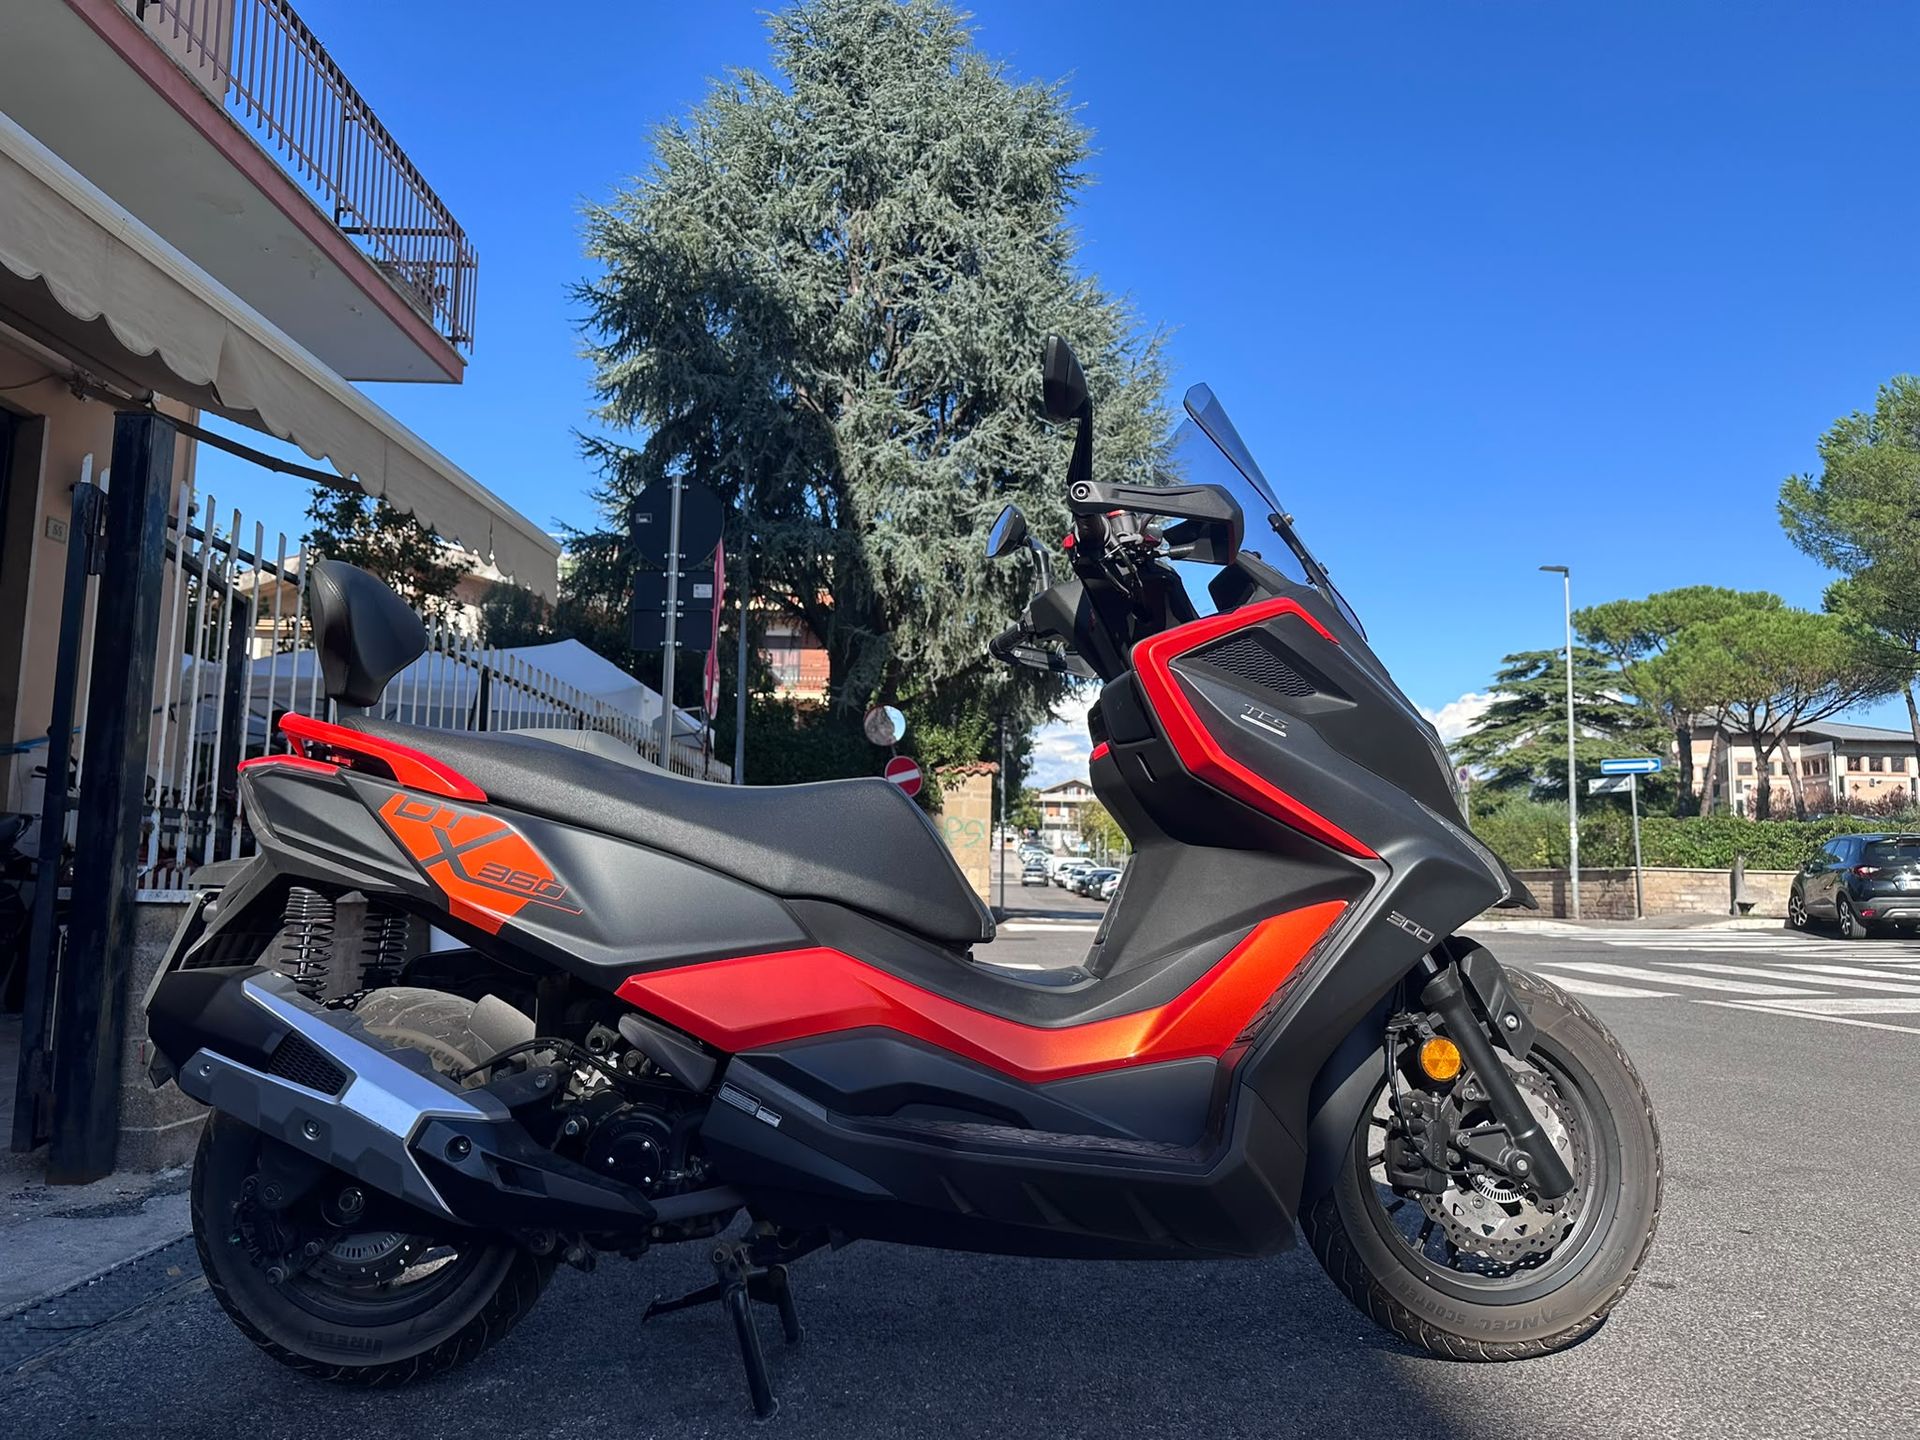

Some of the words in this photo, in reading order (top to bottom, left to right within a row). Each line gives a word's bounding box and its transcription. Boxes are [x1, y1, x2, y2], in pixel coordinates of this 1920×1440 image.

[1244, 703, 1289, 729] TCS
[477, 861, 569, 901] 360
[1386, 910, 1435, 944] 300
[1397, 1281, 1468, 1327] SCOOTER
